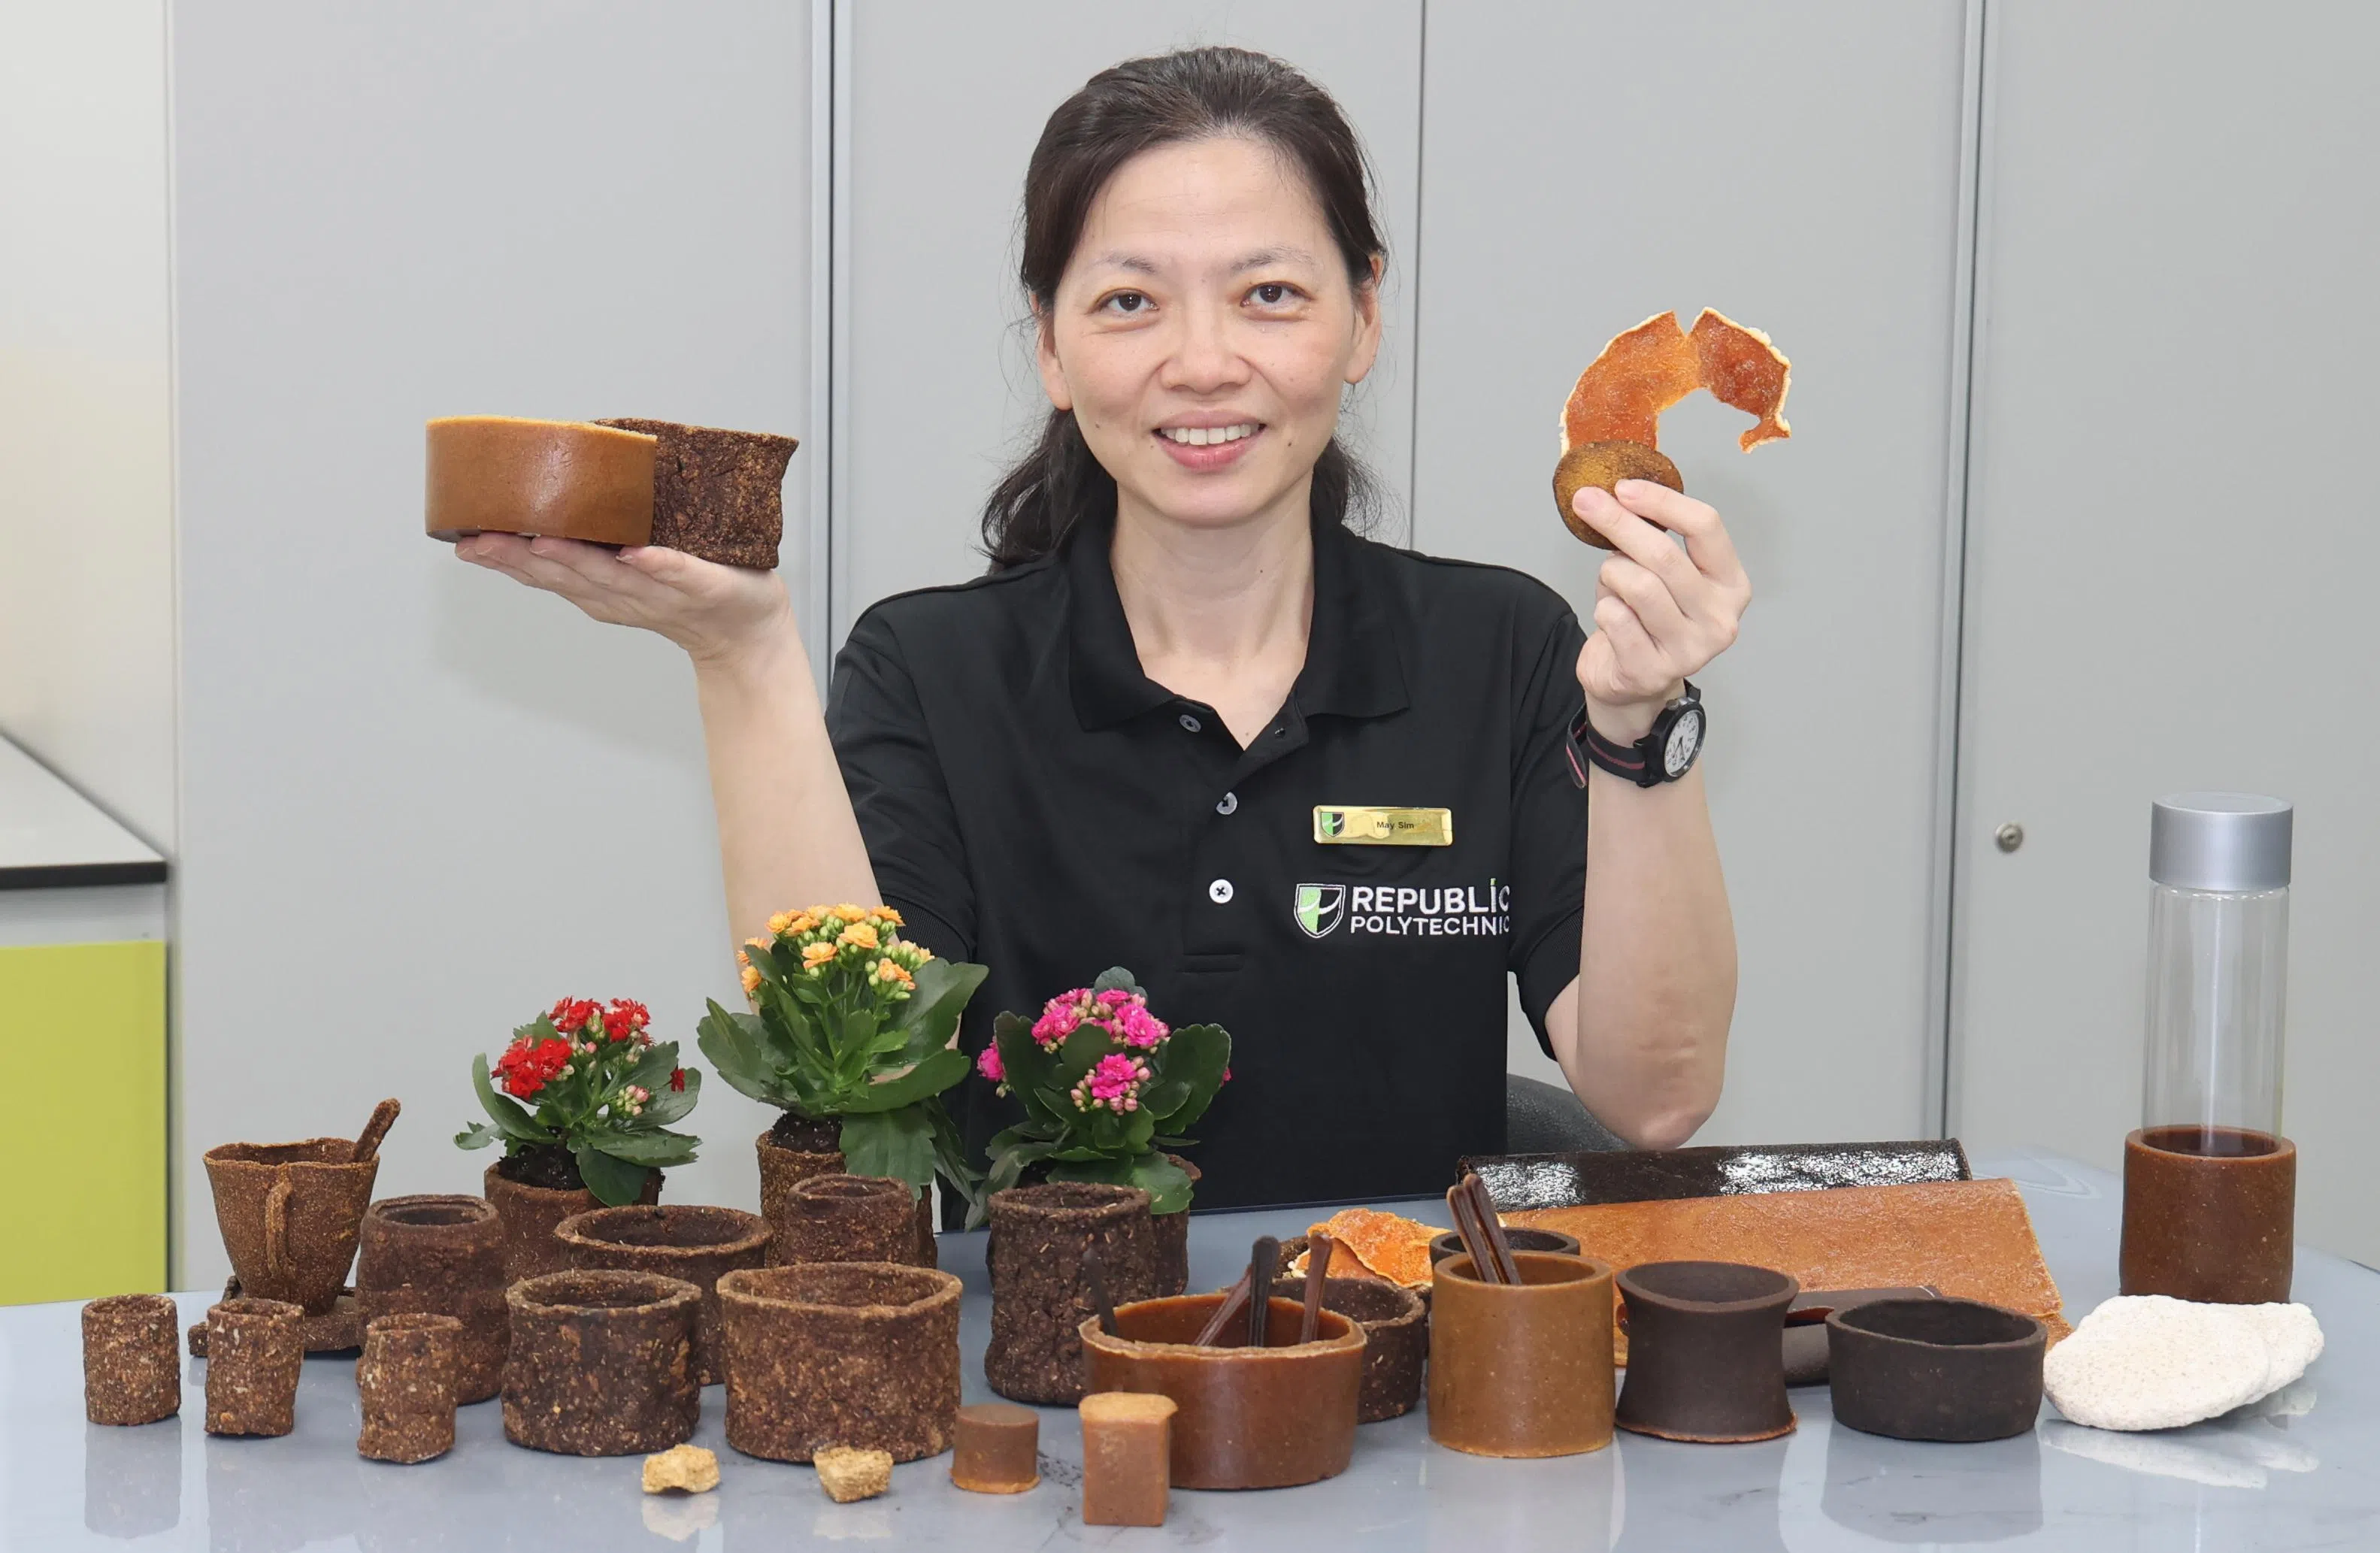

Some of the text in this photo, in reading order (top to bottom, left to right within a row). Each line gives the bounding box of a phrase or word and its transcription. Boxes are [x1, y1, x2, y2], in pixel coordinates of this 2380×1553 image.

[1376, 822, 1394, 830] May
[1352, 878, 1510, 914] REPUBLIC
[1351, 916, 1509, 936] POLYTECHNIC
